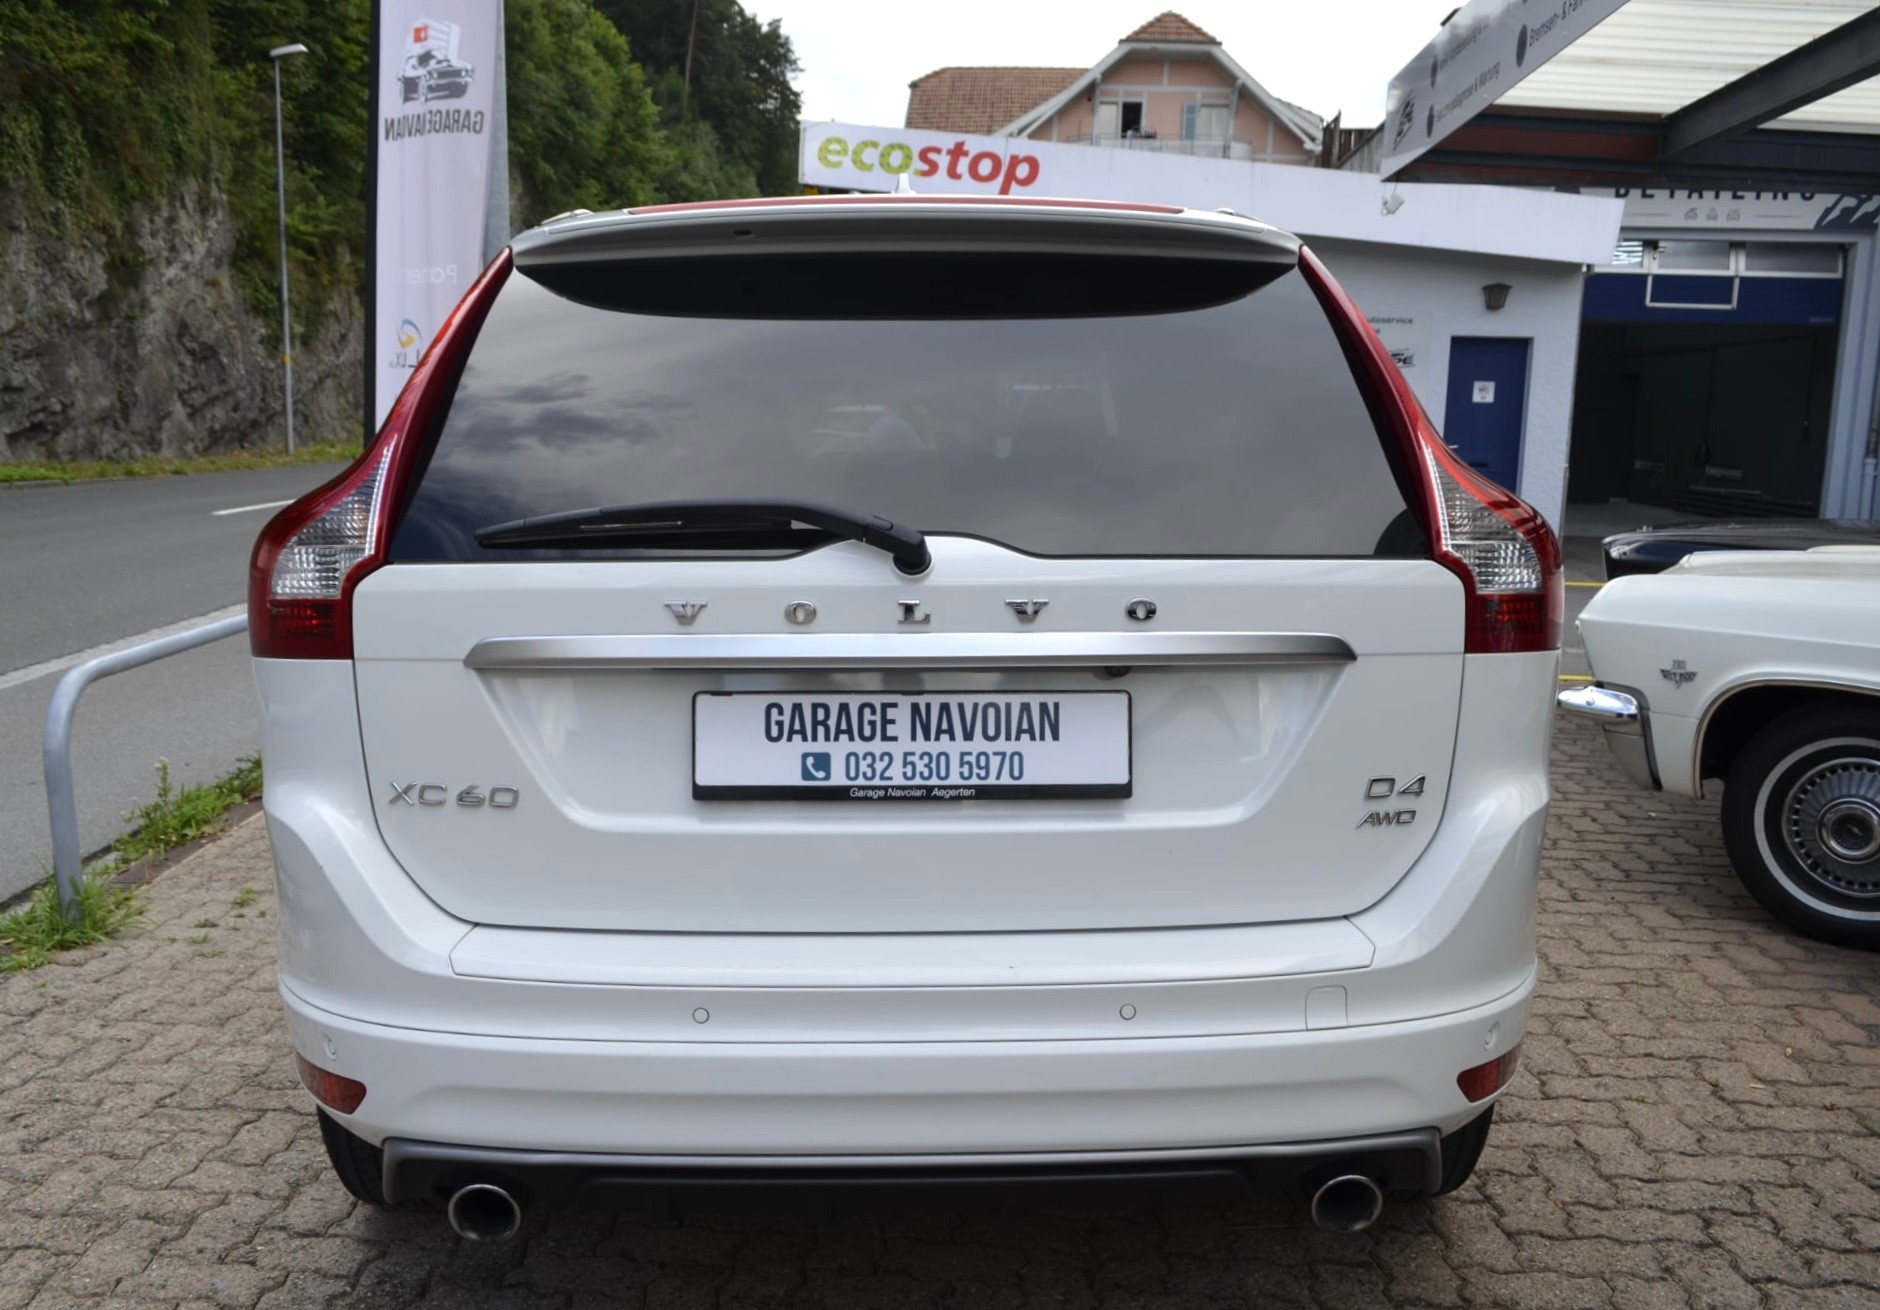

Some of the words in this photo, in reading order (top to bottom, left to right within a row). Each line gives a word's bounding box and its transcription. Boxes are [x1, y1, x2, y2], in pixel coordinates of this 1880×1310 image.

[817, 136, 1040, 195] ecostop
[664, 599, 1157, 626] VOLVO
[764, 702, 898, 743] GARAGE
[910, 701, 1060, 742] NAVOIAN
[844, 751, 894, 781] 032
[902, 751, 950, 781] 530
[959, 751, 1024, 781] 5970
[389, 781, 519, 809] XC60
[849, 787, 885, 799] Garage
[887, 787, 926, 797] Navoian
[931, 788, 976, 799] Aegerten
[1364, 774, 1426, 800] D4
[1357, 808, 1417, 828] AWD
